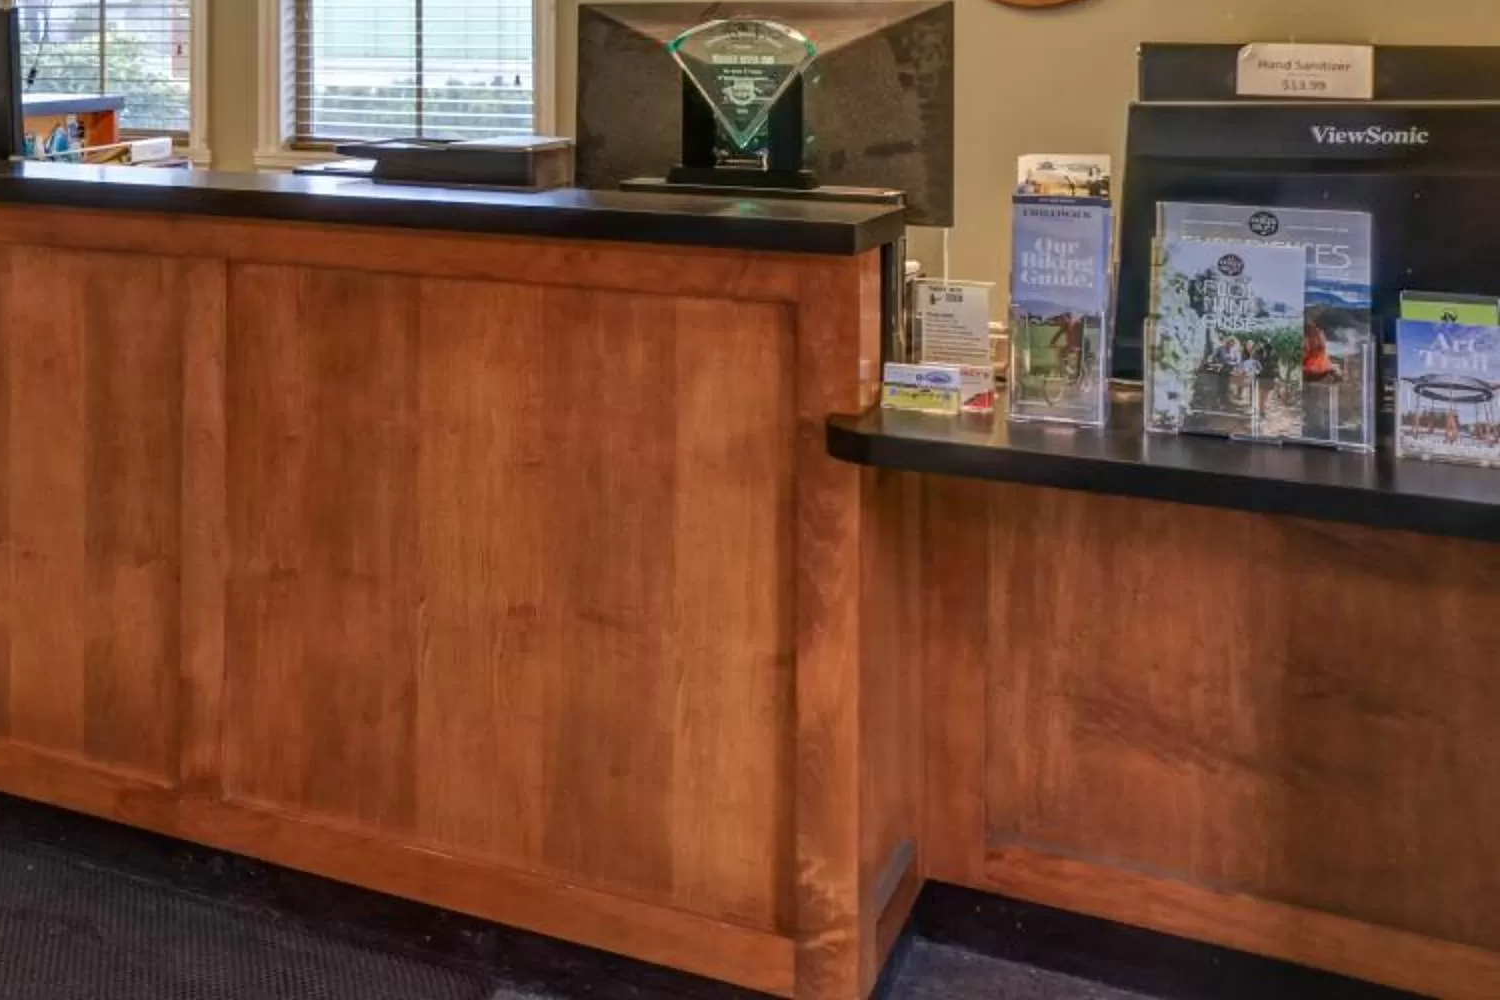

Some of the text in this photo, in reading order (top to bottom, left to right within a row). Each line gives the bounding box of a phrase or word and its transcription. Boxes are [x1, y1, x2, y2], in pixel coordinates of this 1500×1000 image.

[1257, 59, 1352, 72] Hand Sanitizer
[1310, 125, 1429, 145] ViewSonic
[1035, 237, 1080, 256] Our
[1020, 252, 1095, 273] Biking
[1430, 331, 1478, 353] Art
[1418, 350, 1489, 374] Trail
